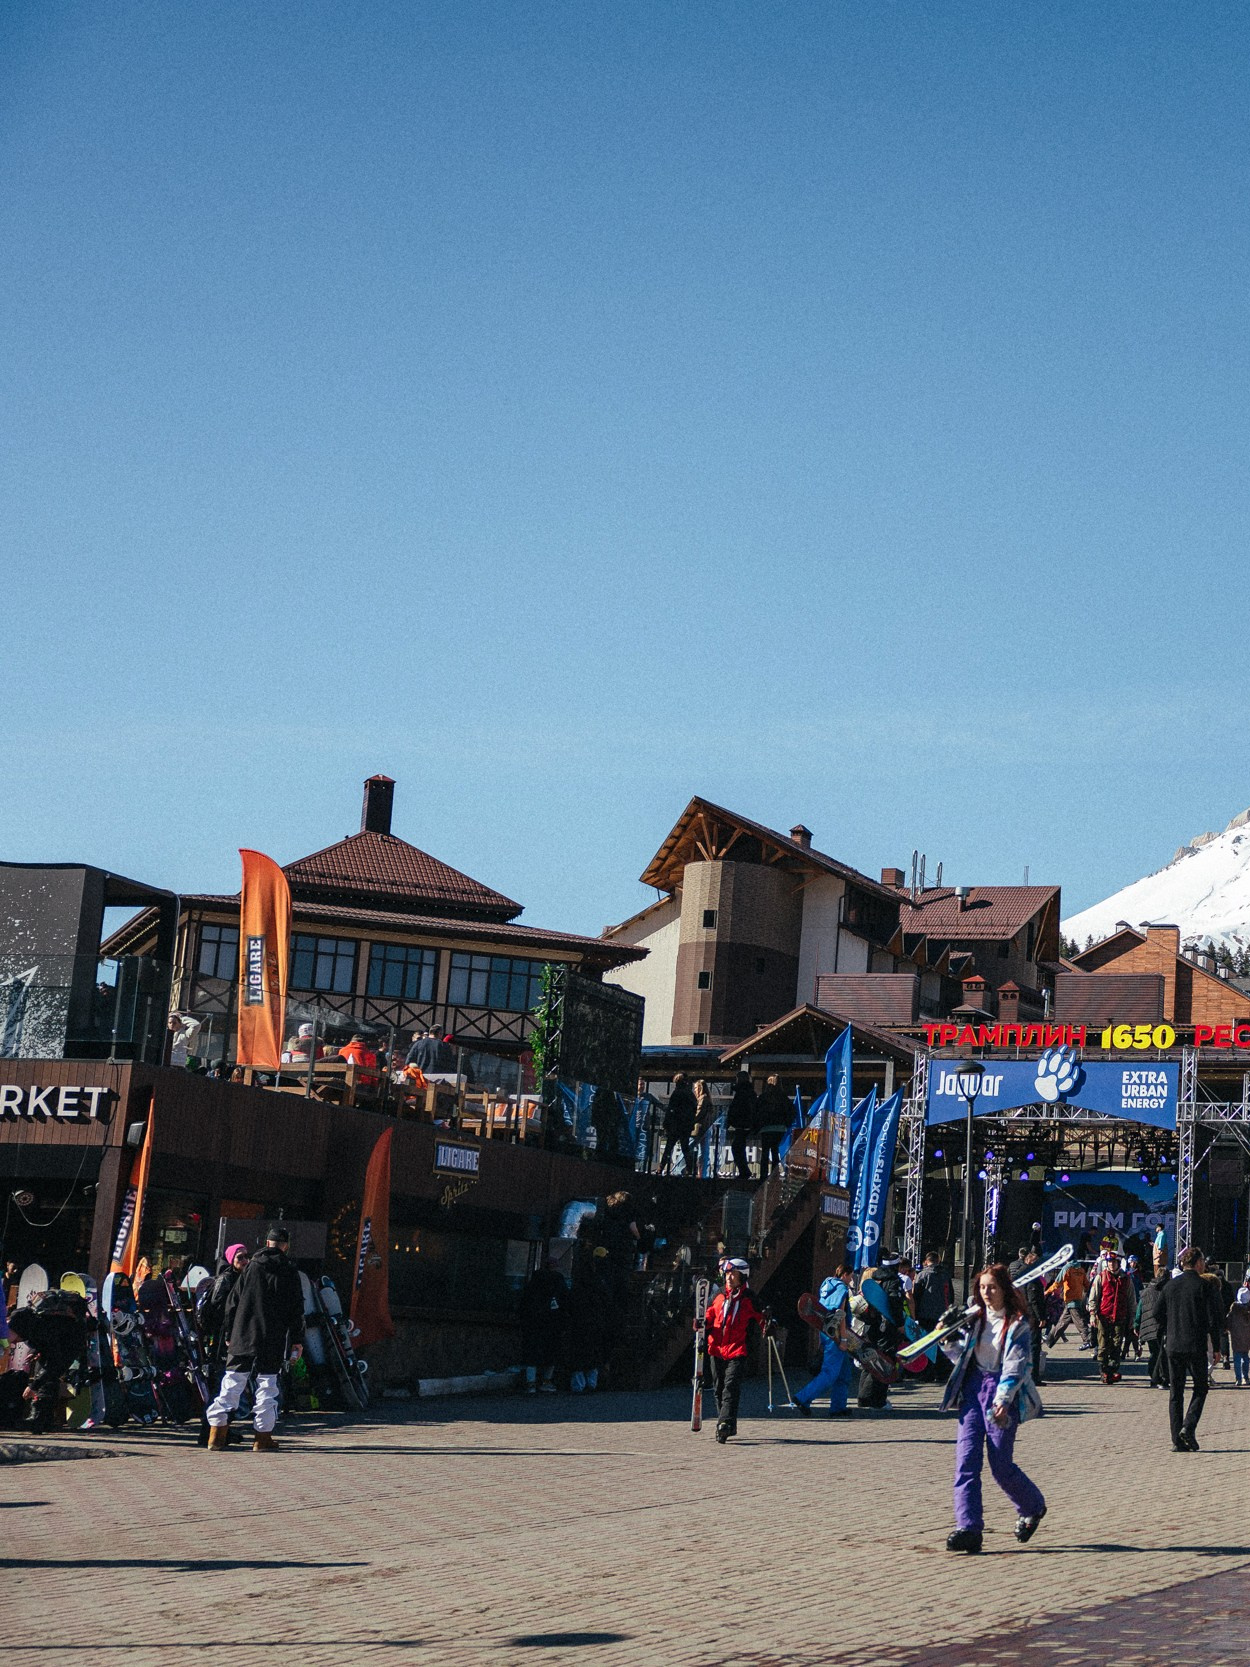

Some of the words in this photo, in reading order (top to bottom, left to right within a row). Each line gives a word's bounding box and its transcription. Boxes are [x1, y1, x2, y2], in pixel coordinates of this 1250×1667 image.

[249, 939, 262, 1001] LIGARE
[922, 1024, 1087, 1047] ТРАМПЛИН
[1101, 1024, 1176, 1049] 1650
[936, 1071, 1004, 1101] Jaguar
[1123, 1071, 1168, 1084] EXTRA
[0, 1085, 108, 1117] RKET
[1121, 1084, 1168, 1097] URBAN
[1121, 1098, 1166, 1109] ENERGY
[437, 1145, 480, 1171] LIGARE
[1054, 1211, 1124, 1229] РИТМ
